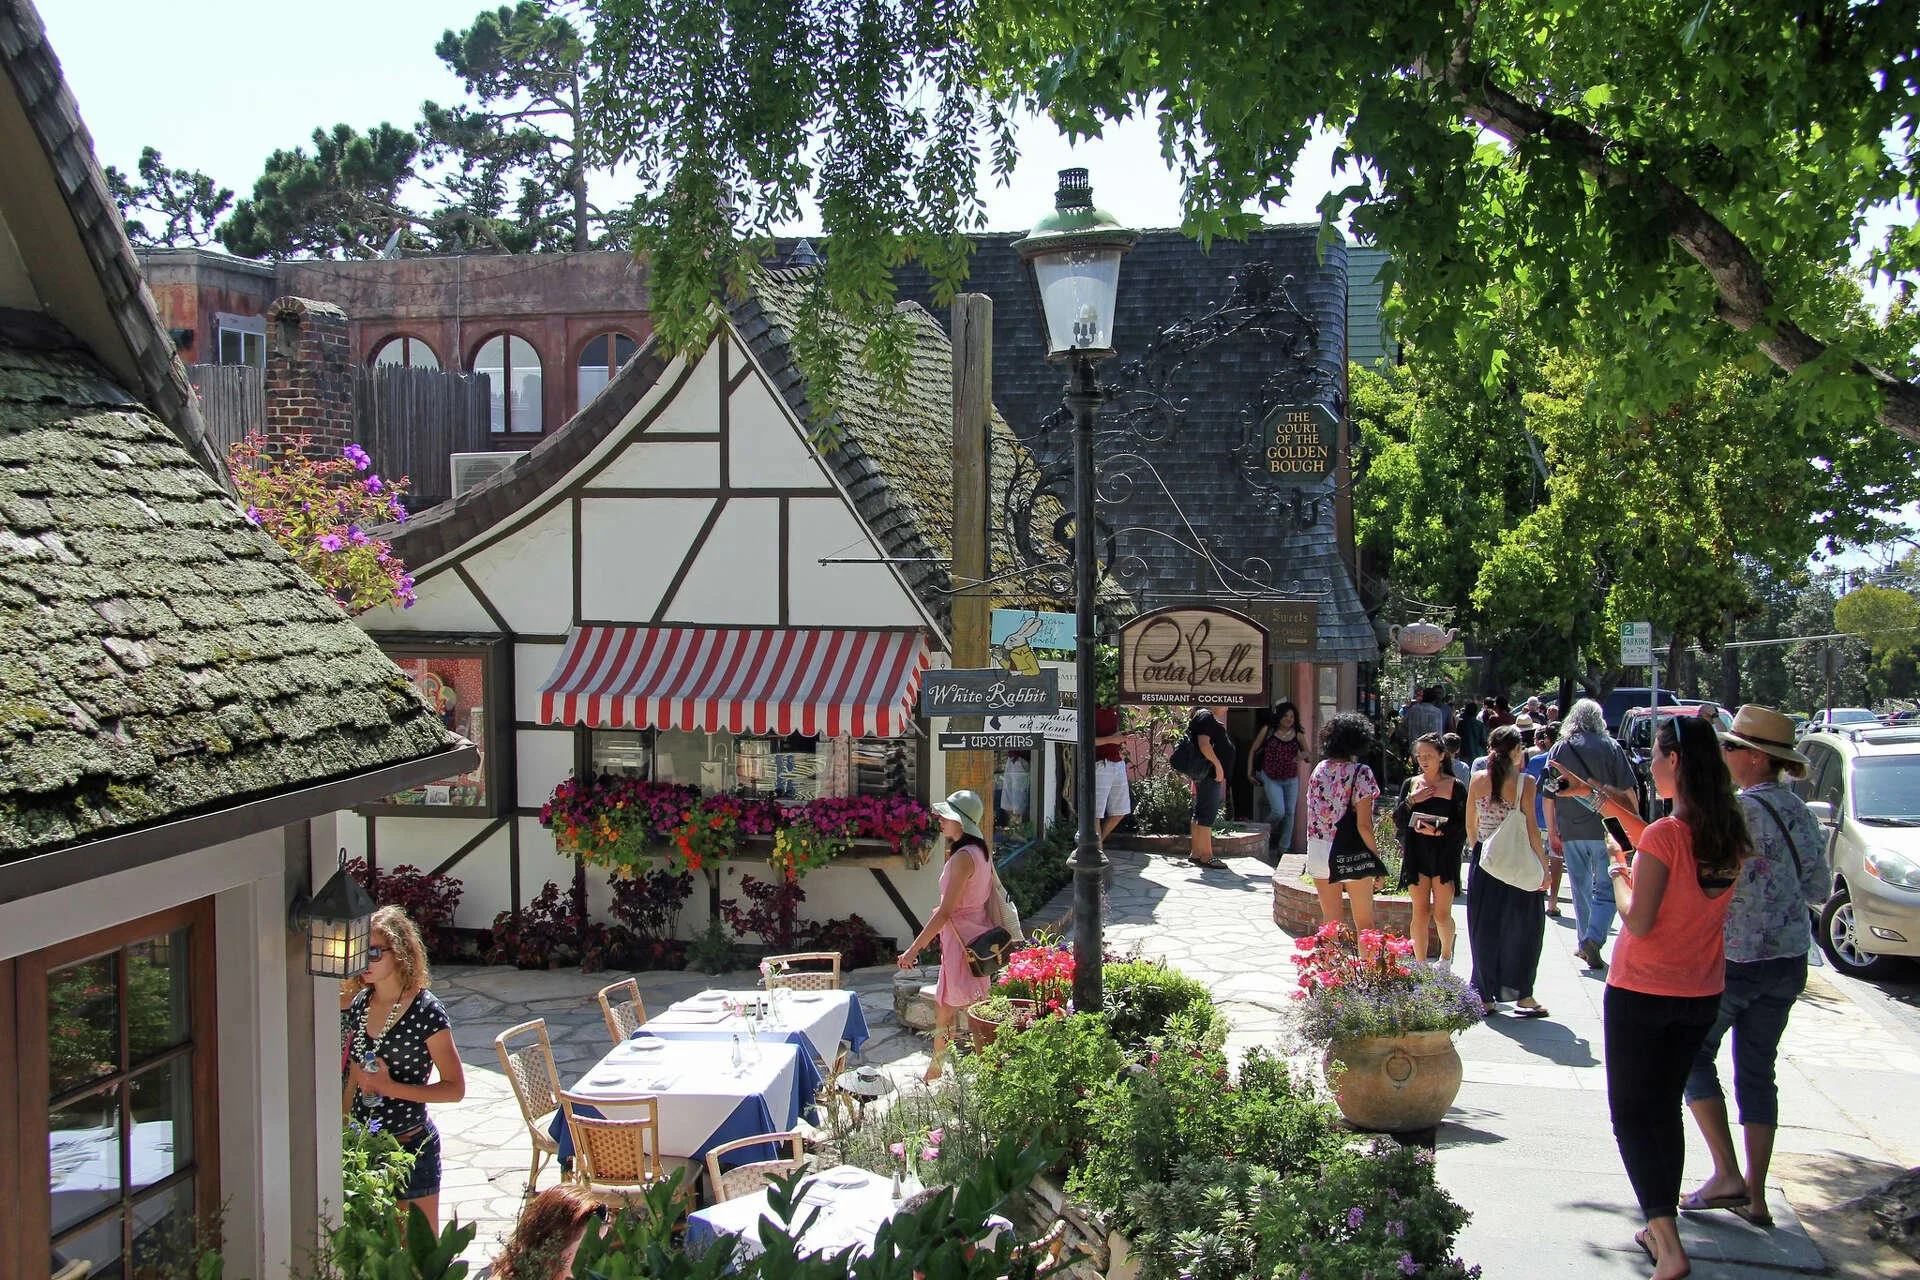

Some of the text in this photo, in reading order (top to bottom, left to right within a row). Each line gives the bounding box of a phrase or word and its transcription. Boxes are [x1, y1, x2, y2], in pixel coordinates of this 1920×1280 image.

[1287, 412, 1311, 422] THE
[1277, 423, 1318, 434] COURT
[1276, 434, 1319, 445] OF THE
[1267, 445, 1328, 459] GOLDEN
[1270, 460, 1325, 473] BOUGH
[1624, 625, 1632, 635] 2
[1133, 616, 1254, 691] Porta Bella
[928, 680, 1048, 709] White Rabbit
[1141, 693, 1244, 703] RESTAURANT COCKTAILS
[1037, 722, 1071, 733] Home
[971, 735, 1034, 748] UPSTAIRS
